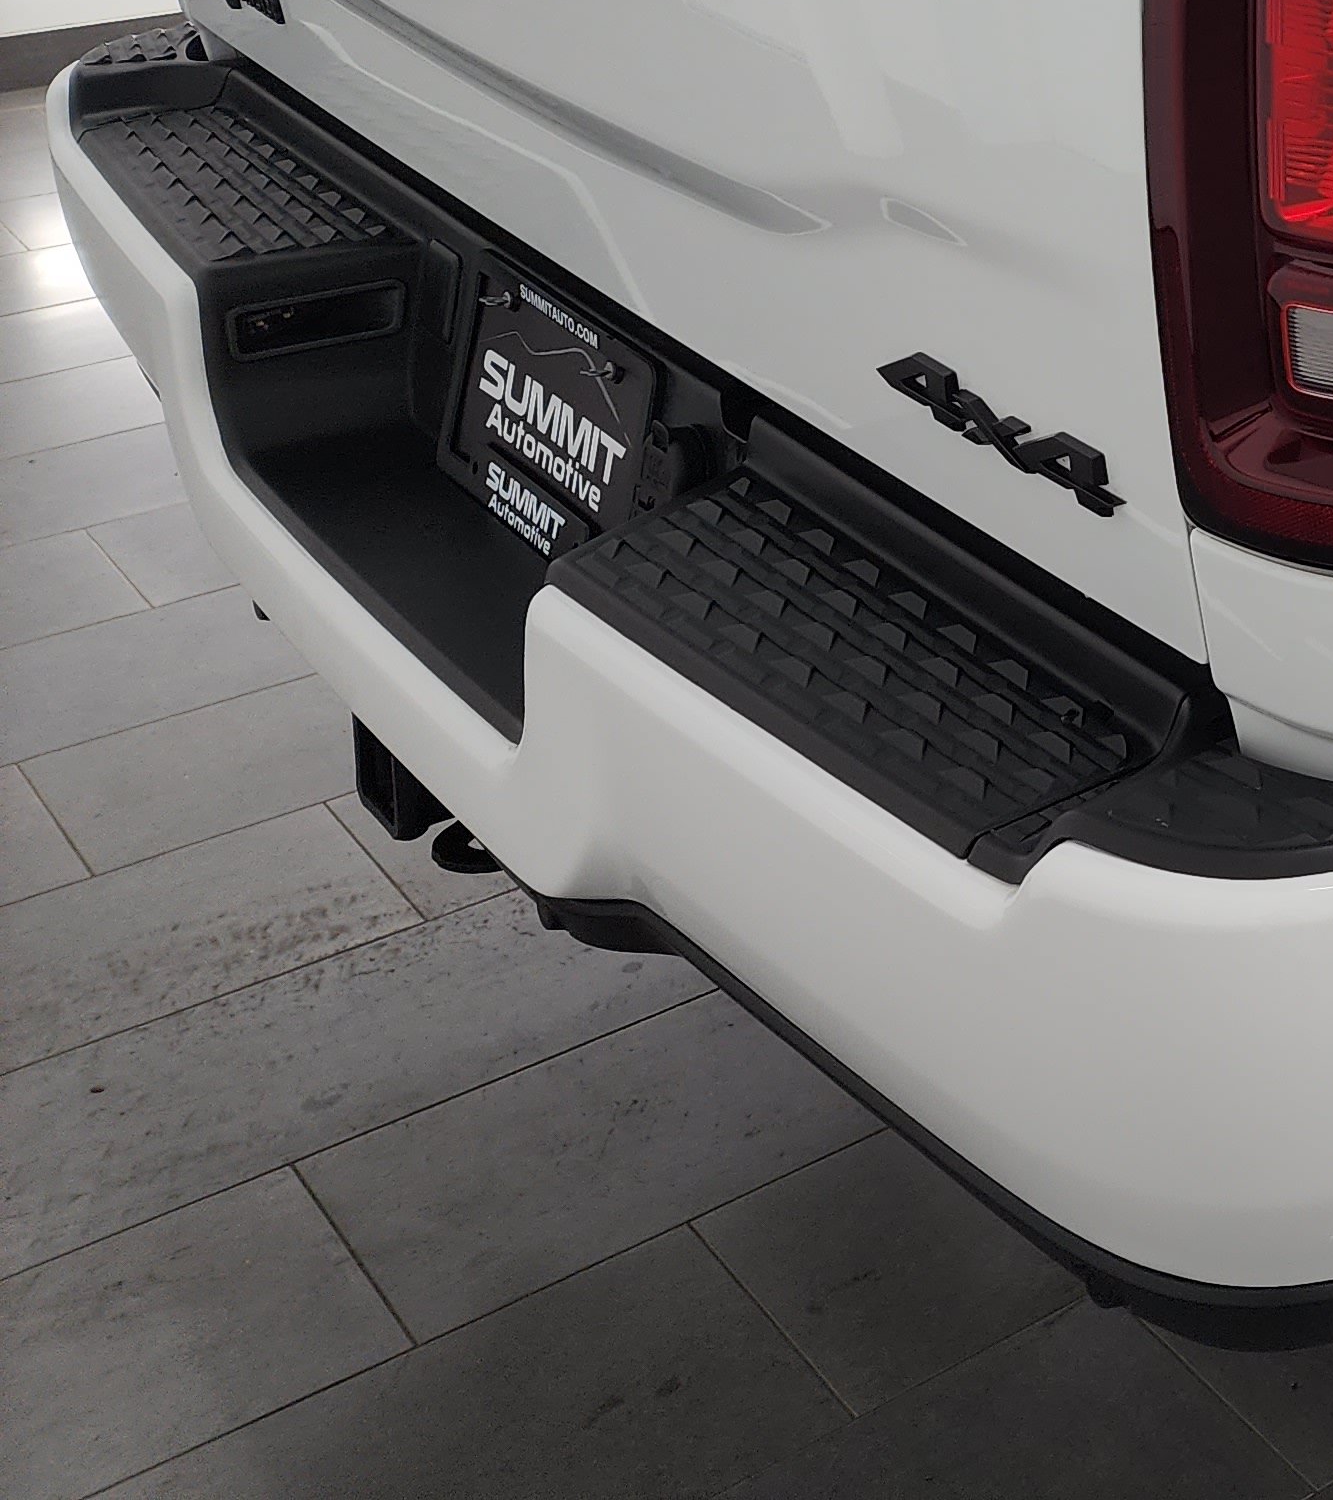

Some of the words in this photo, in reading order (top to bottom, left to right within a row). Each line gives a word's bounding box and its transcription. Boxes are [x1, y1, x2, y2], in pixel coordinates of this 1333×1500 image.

[519, 284, 599, 349] SUMMITAUTO.COM
[479, 349, 627, 485] SUMMIT
[485, 403, 601, 513] Automotive
[486, 461, 565, 540] SUMMIT
[488, 503, 551, 556] Automotive
